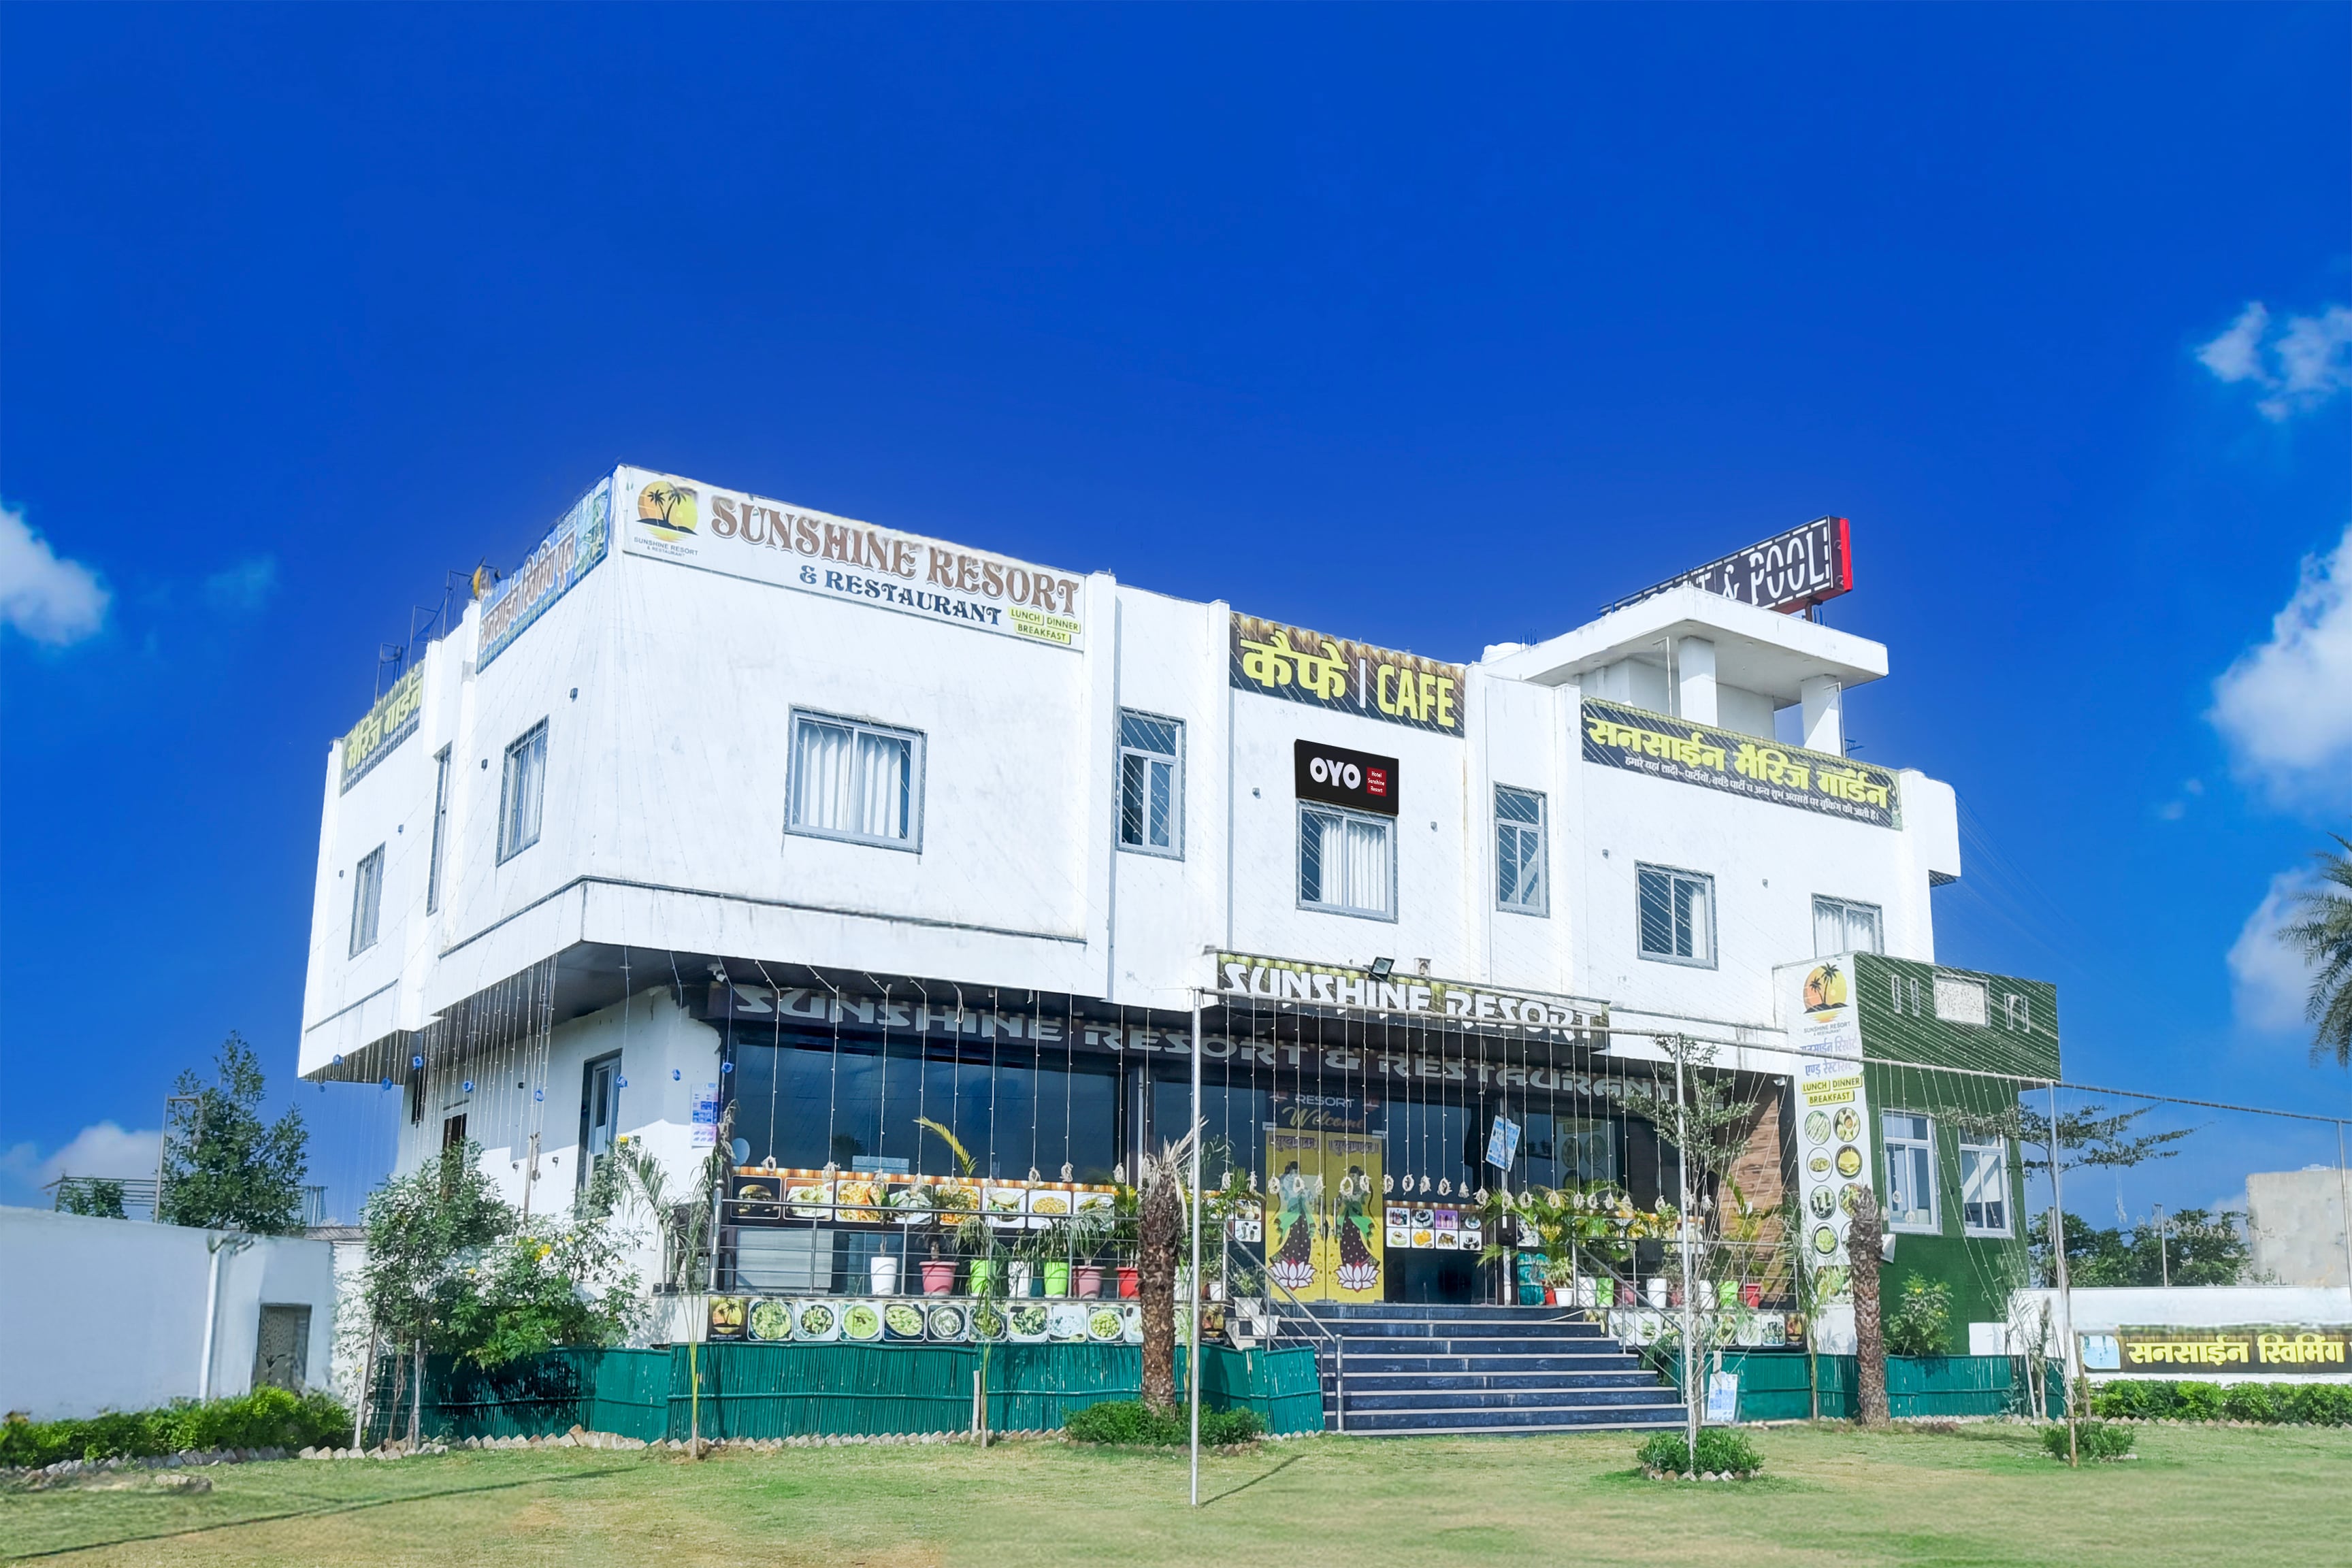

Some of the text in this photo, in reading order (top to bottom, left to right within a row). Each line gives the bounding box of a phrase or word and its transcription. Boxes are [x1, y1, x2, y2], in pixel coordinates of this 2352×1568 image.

[634, 536, 698, 556] SUNSHINE RESORT
[710, 495, 1080, 616] SUNSHINE RESORT
[1749, 531, 1825, 606] POOL
[800, 565, 1002, 626] & RESTAURANT
[1011, 609, 1078, 632] LUNCH DINNER
[1017, 623, 1066, 641] BREAKFAST
[1377, 664, 1455, 728] CAFE
[1310, 757, 1361, 789] OYO
[1733, 743, 1810, 790] मैरिज
[1367, 778, 1385, 786] Sunshine
[1370, 785, 1383, 794] Resort
[1224, 962, 1603, 1041] SUNSHINE RESORT
[1803, 1021, 1850, 1034] SUNSHINE RESORT
[734, 984, 1676, 1102] SUNSHINE RESORT & RESTAURANT
[1803, 1077, 1860, 1092] LUNCH DINNER
[1295, 1094, 1355, 1108] RESORT
[1809, 1092, 1850, 1104] BREAKFAST
[1282, 1106, 1364, 1129] Welcome
[2126, 1334, 2249, 1367] सनसाईन
